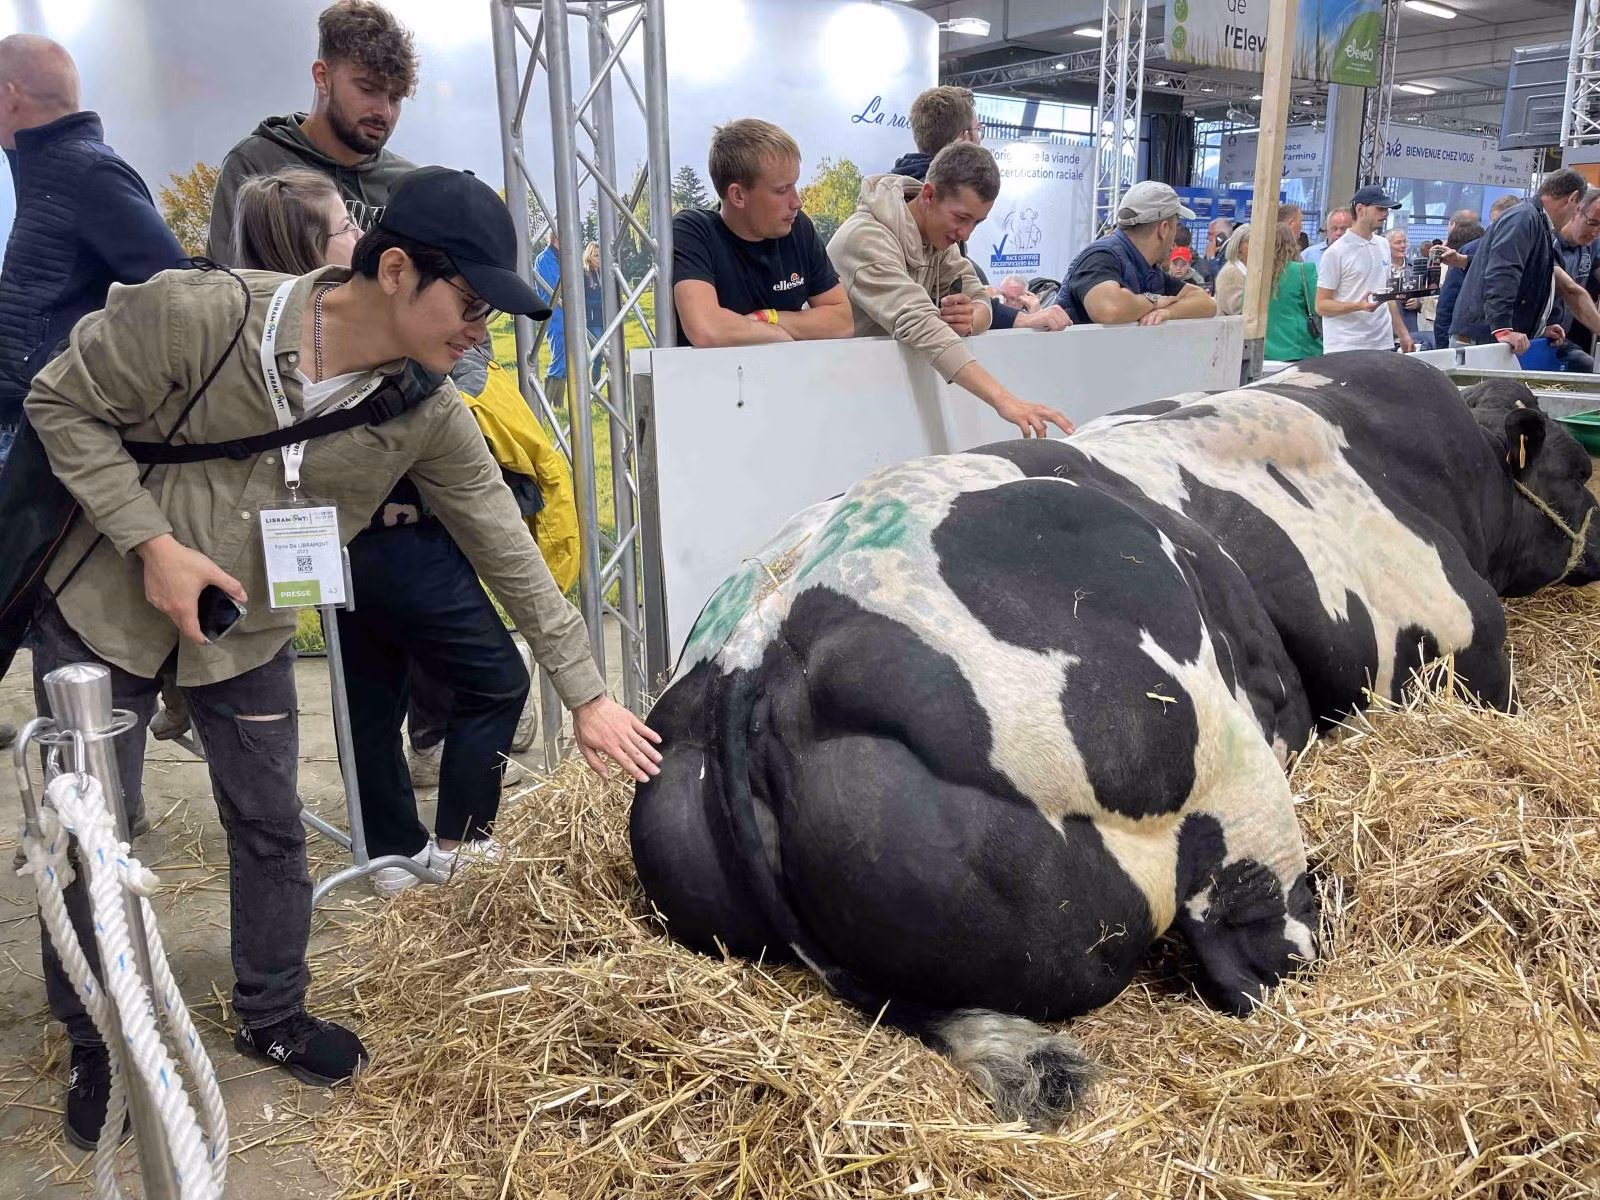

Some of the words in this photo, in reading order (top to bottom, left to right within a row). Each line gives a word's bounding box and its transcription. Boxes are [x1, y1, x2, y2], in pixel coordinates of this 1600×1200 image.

[851, 95, 885, 125] La
[1042, 150, 1050, 162] la
[1051, 152, 1081, 164] viande
[1283, 152, 1317, 161] Farming
[1405, 145, 1441, 160] BIENVENUE
[1441, 149, 1458, 161] CHEZ
[1458, 151, 1475, 163] VOUS
[1055, 170, 1084, 181] raciale
[280, 590, 312, 598] PRESSE
